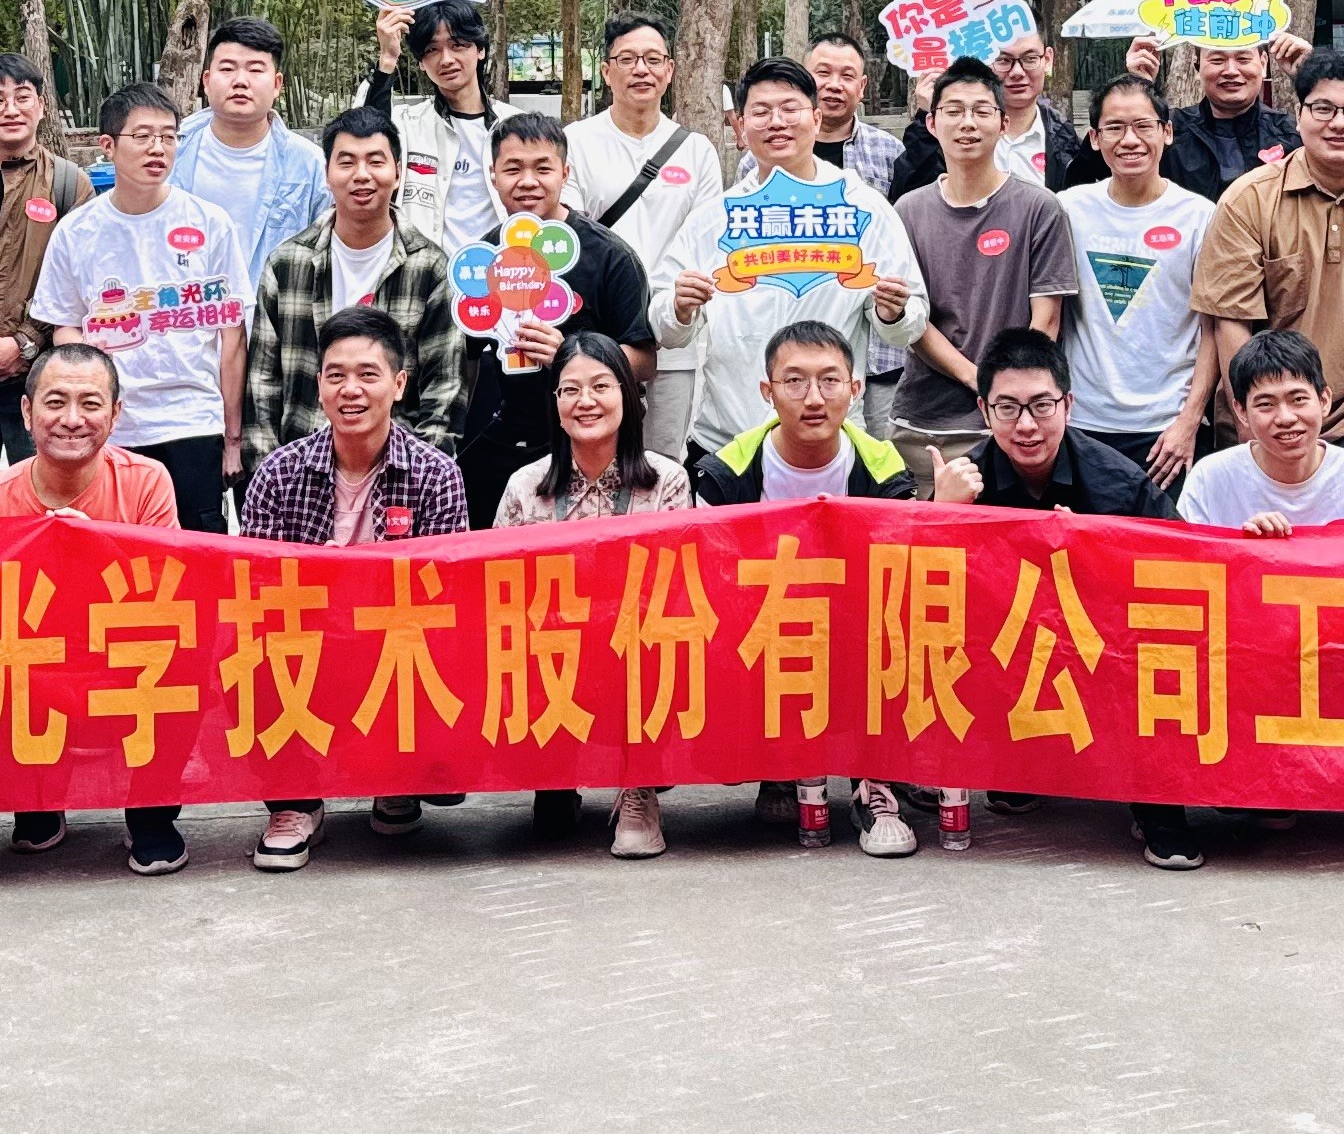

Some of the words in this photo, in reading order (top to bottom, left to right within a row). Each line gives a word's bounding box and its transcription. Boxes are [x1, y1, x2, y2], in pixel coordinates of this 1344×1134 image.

[912, 4, 1031, 72] 最棒的
[1174, 7, 1276, 40] 往前冲
[728, 204, 859, 238] 共赢未来
[494, 266, 536, 279] Happy
[744, 248, 842, 267] 共创美好未来
[133, 279, 227, 311] 主角光环
[499, 281, 546, 291] Birthday
[147, 301, 243, 332] 幸运相伴
